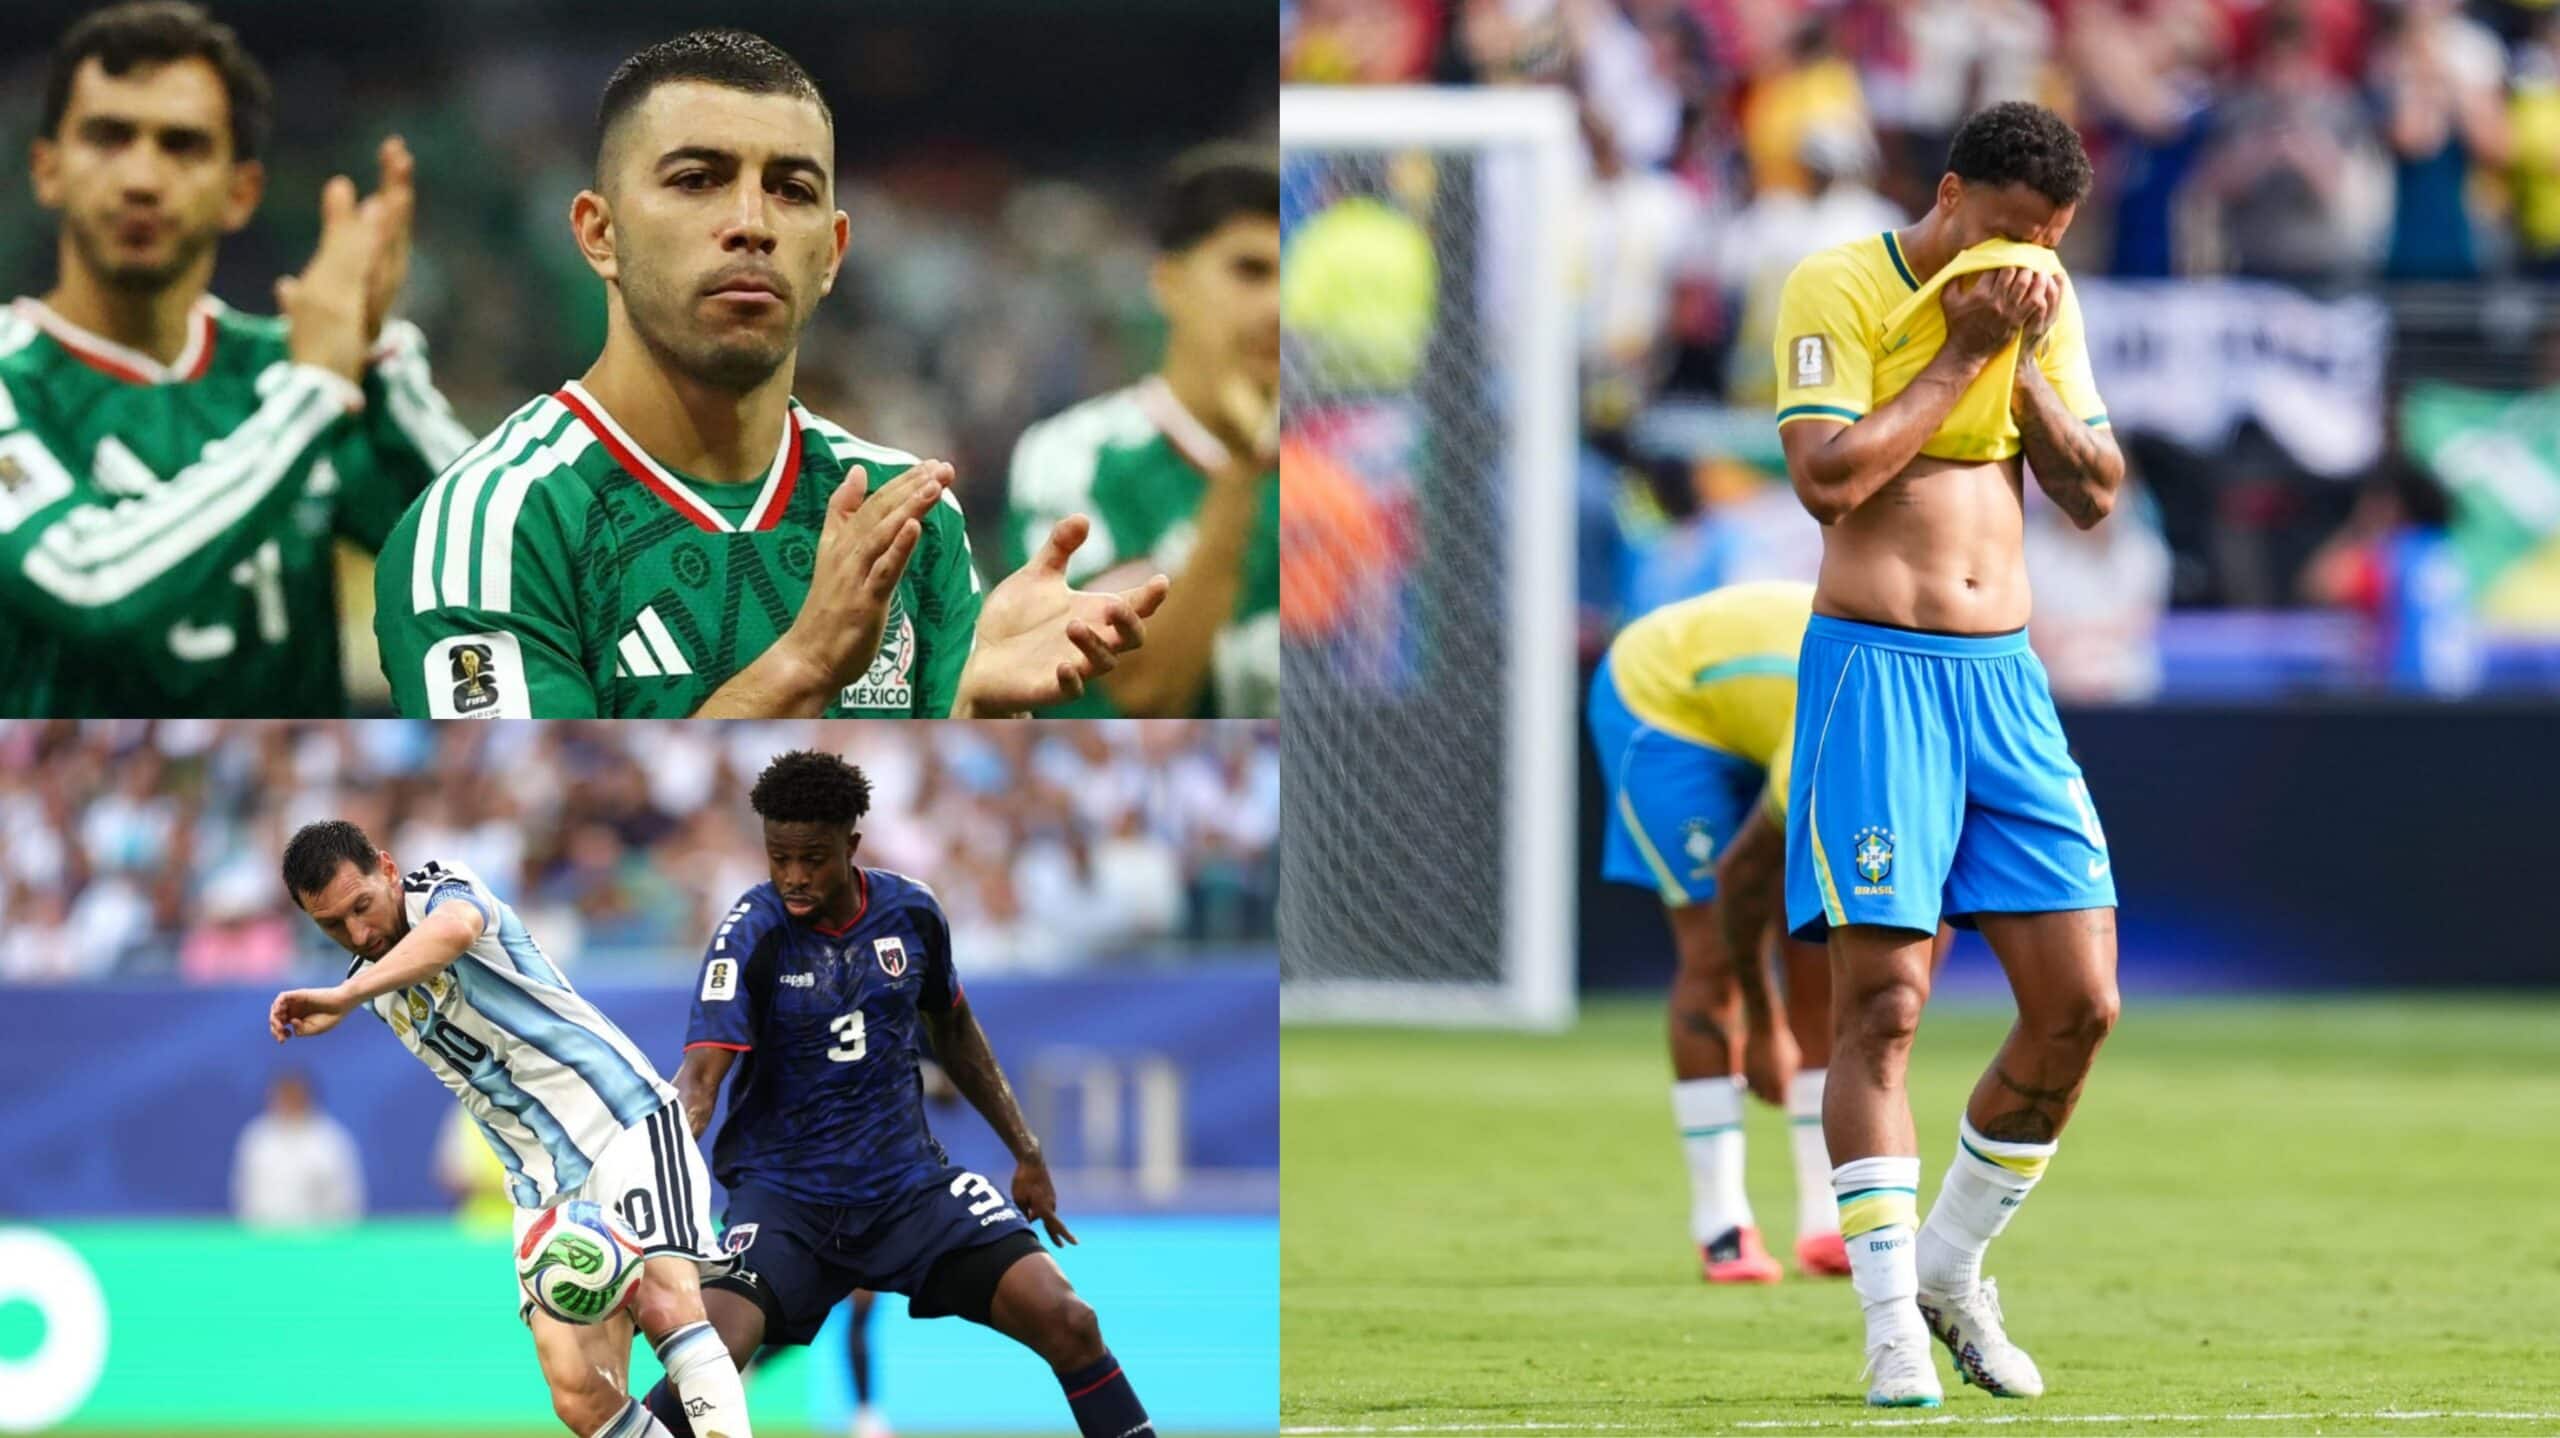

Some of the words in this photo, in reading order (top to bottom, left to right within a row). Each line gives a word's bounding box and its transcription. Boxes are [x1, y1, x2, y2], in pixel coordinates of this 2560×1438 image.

[465, 696, 488, 707] FIFA
[843, 683, 909, 705] MÉXICO
[1854, 886, 1896, 895] BRASIL
[827, 1010, 866, 1062] 3
[950, 1172, 1005, 1216] 3
